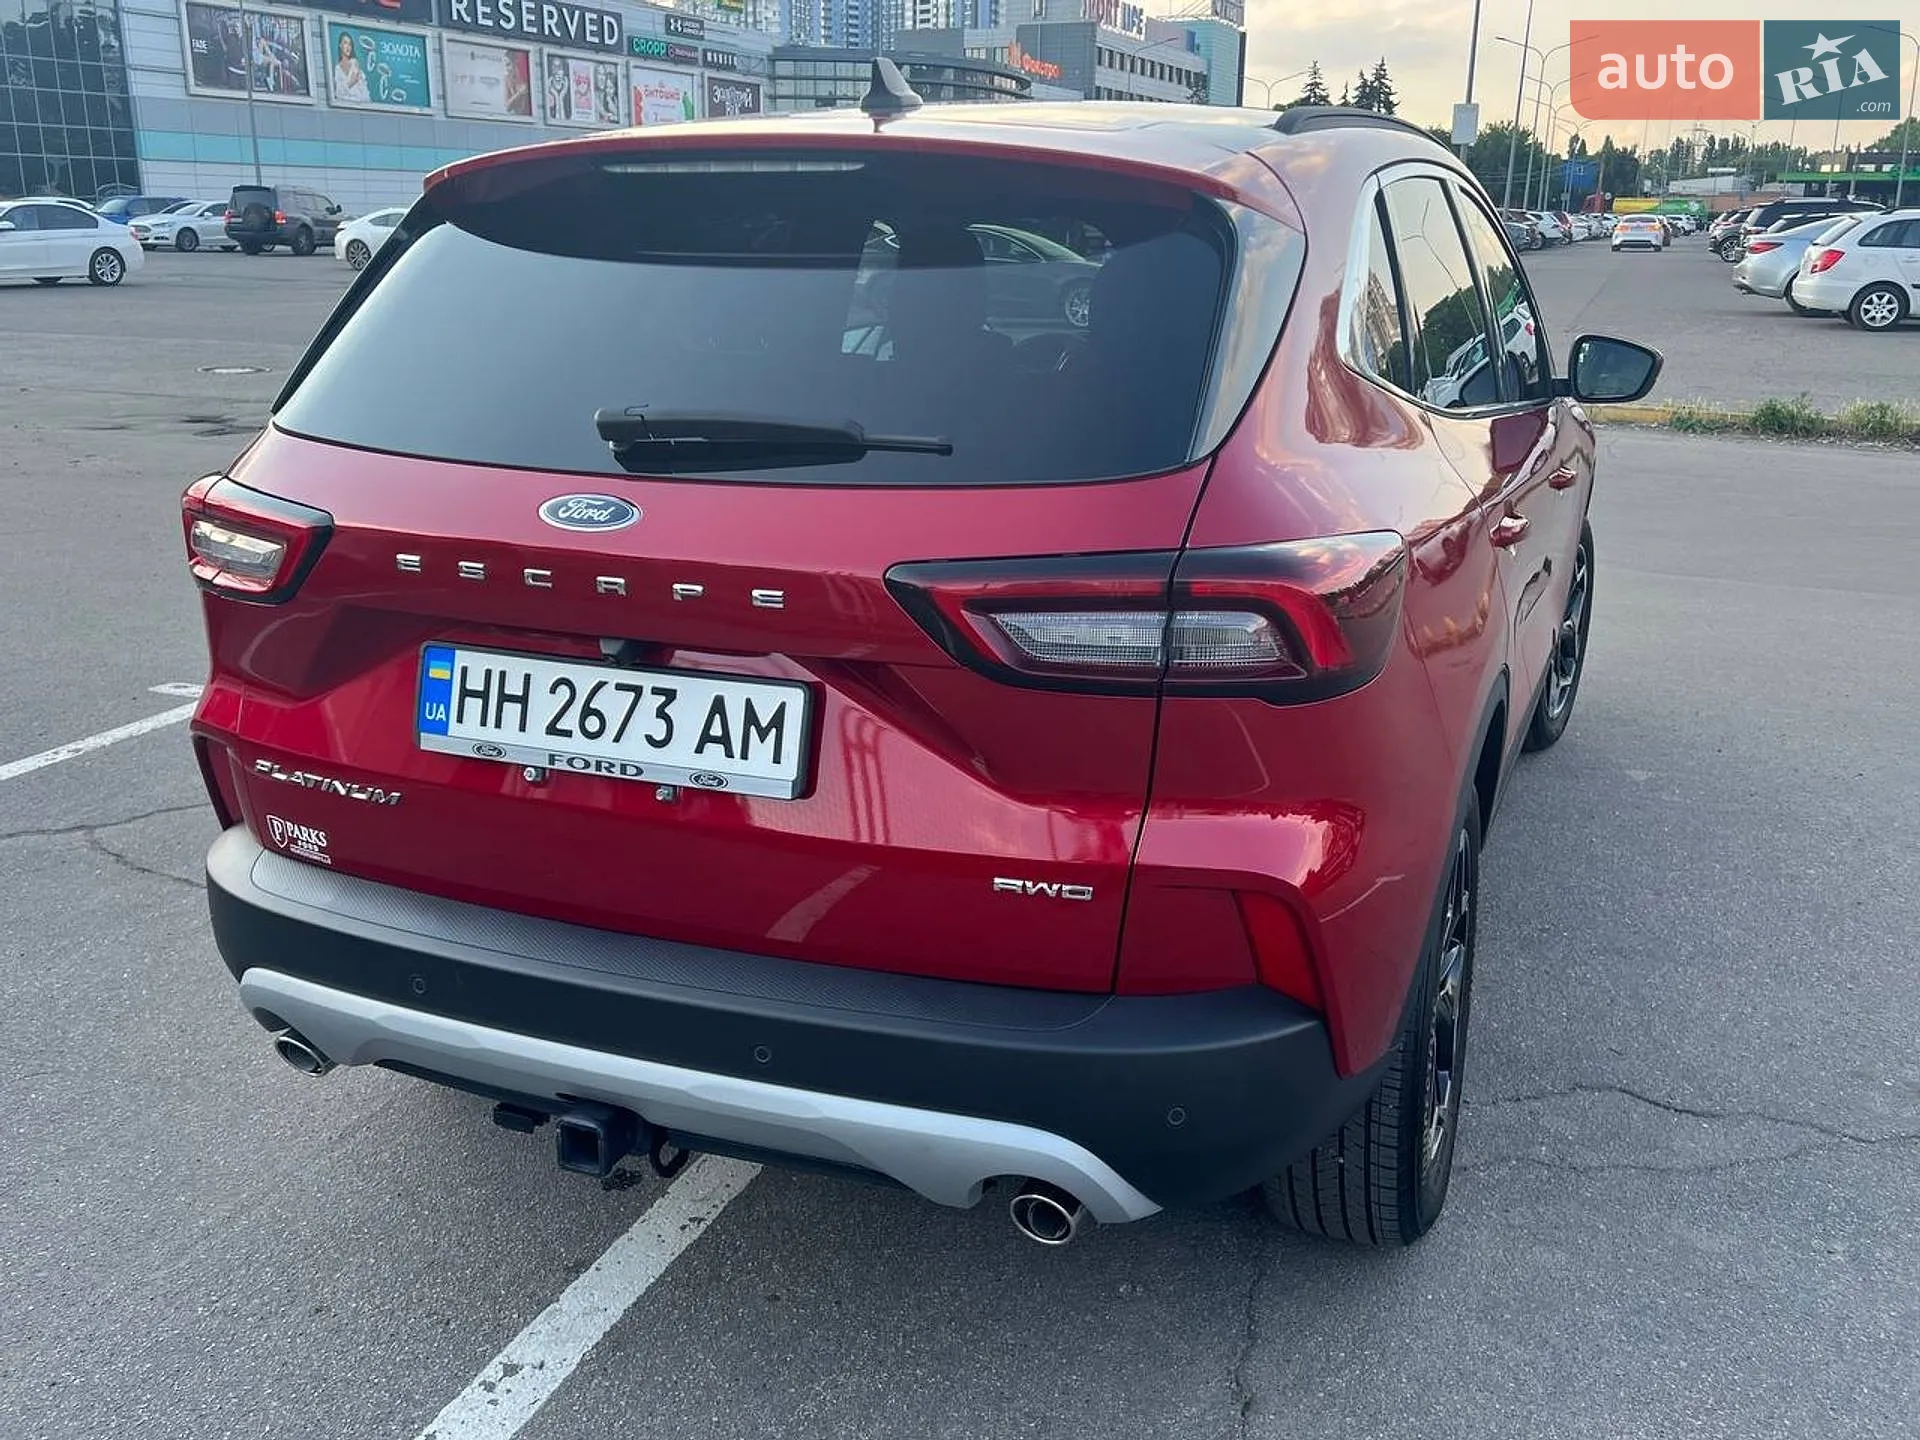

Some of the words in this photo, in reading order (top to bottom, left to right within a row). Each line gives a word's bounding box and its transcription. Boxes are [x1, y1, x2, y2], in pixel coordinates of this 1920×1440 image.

[451, 0, 618, 45] RESERVED
[633, 36, 666, 58] CROPP
[558, 498, 616, 521] Ford
[396, 553, 785, 609] ESCAPE
[424, 702, 447, 722] UA
[455, 664, 532, 733] HH
[544, 676, 679, 749] 2673
[694, 694, 787, 765] AM
[547, 753, 645, 777] FORD
[255, 758, 402, 806] PLATINUM
[285, 820, 327, 847] PARKS
[993, 877, 1094, 901] AWD
